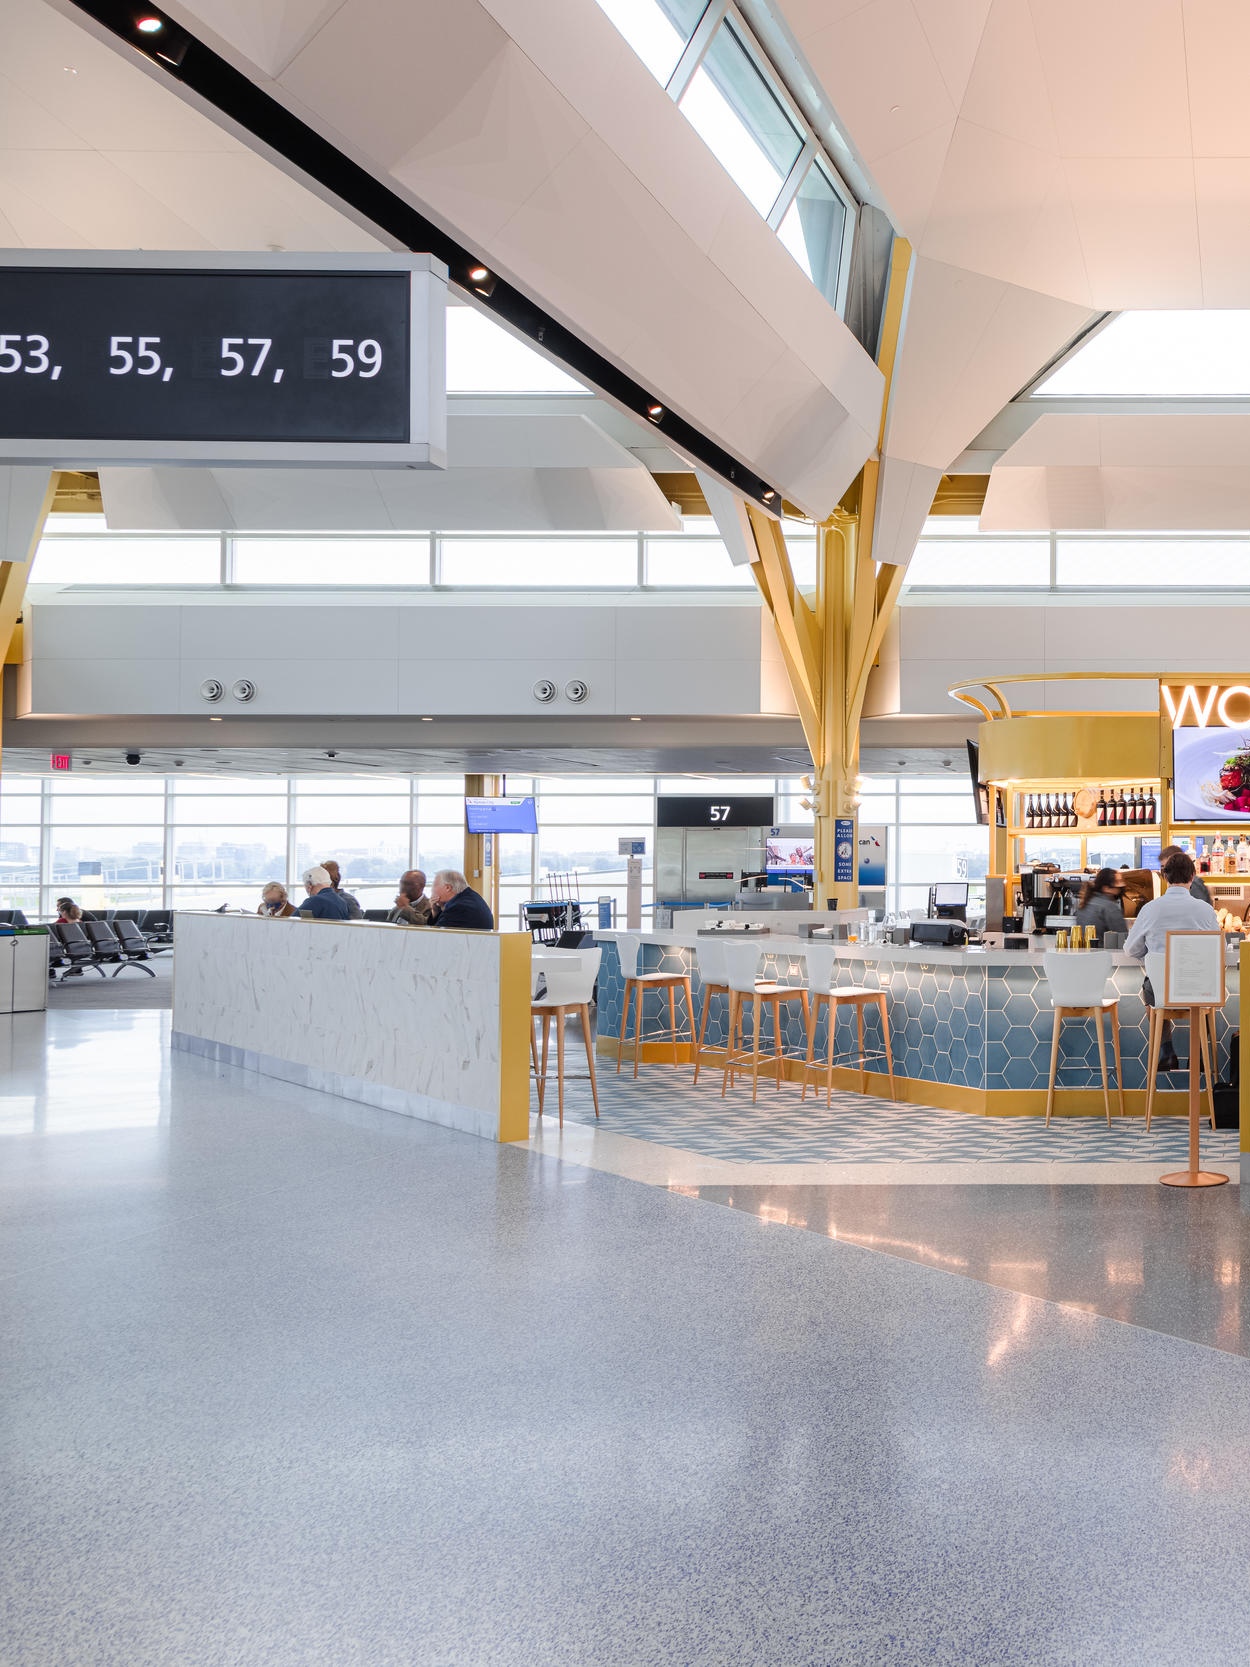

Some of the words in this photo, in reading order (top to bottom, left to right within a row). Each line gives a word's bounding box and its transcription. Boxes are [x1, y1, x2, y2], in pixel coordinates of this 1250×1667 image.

[0, 335, 63, 381] 53,
[109, 336, 174, 382] 55,
[220, 338, 285, 383] 57,
[331, 339, 383, 378] 59
[55, 754, 70, 770] EXIT
[710, 805, 731, 821] 57
[770, 828, 780, 836] 57
